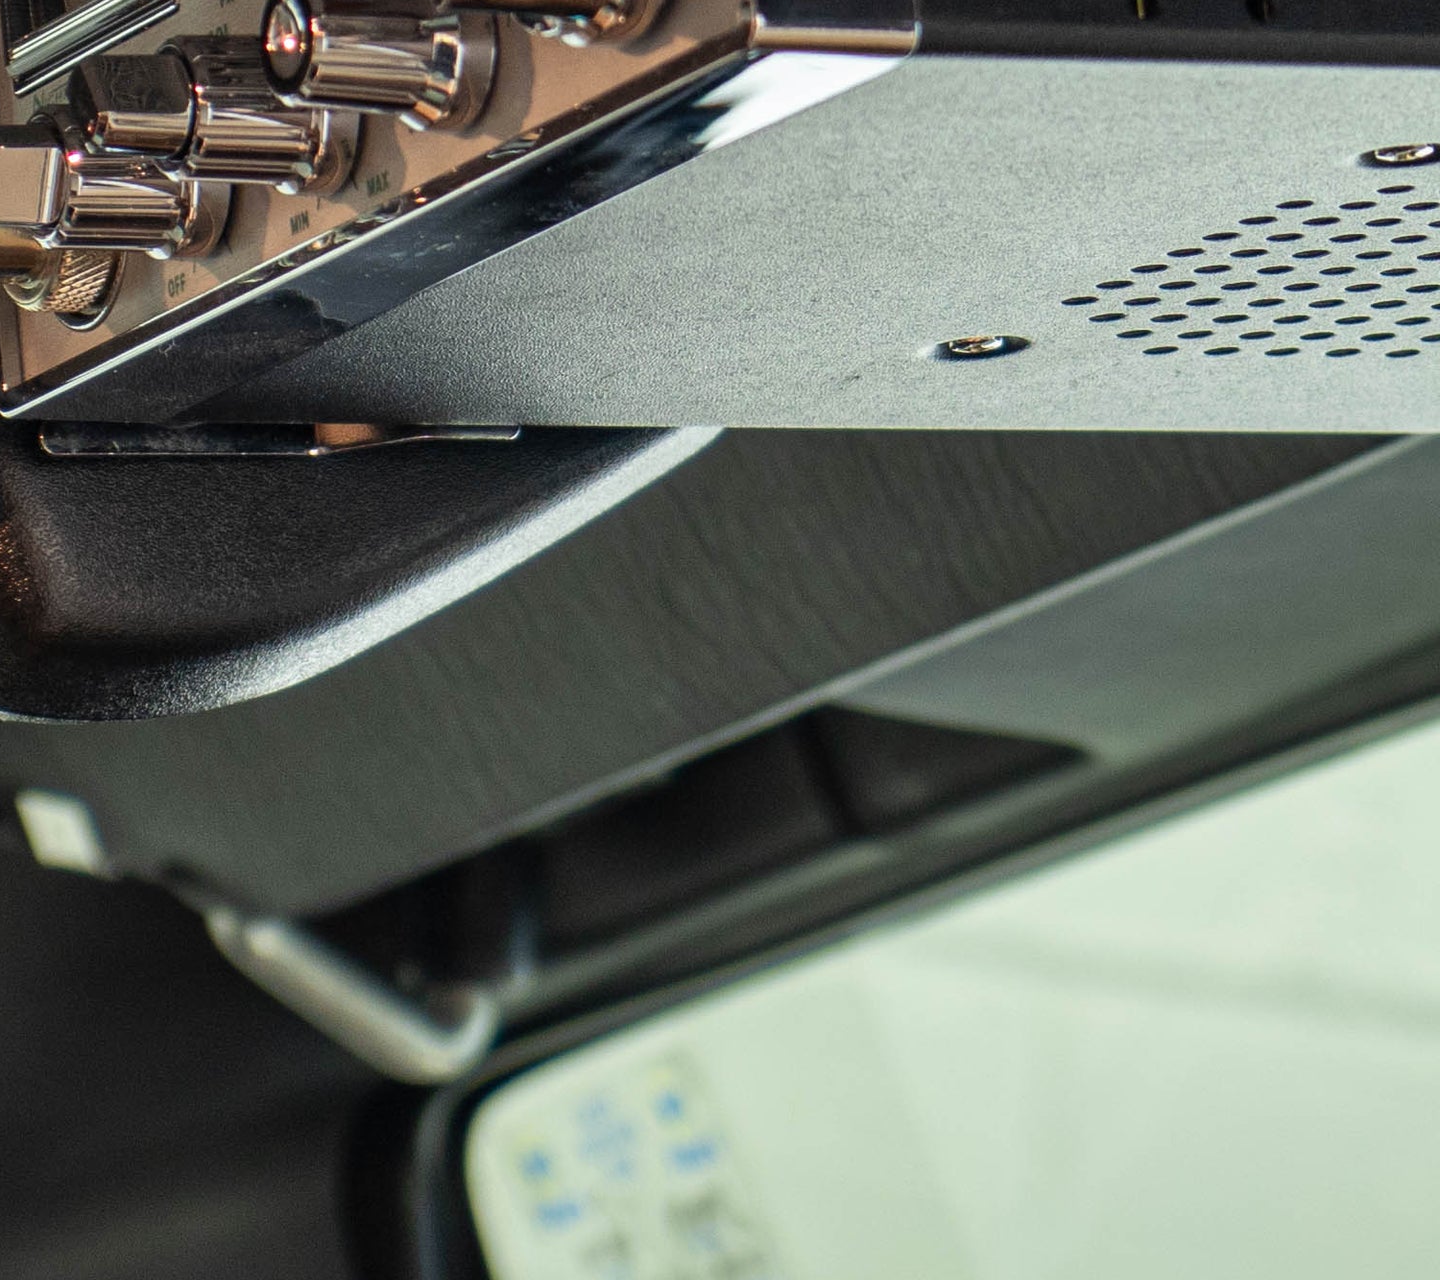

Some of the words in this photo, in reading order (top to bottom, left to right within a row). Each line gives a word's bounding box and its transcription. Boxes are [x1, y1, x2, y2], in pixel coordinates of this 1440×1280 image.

[366, 171, 389, 197] MAX
[289, 210, 310, 235] MIN
[168, 273, 186, 298] OFF
